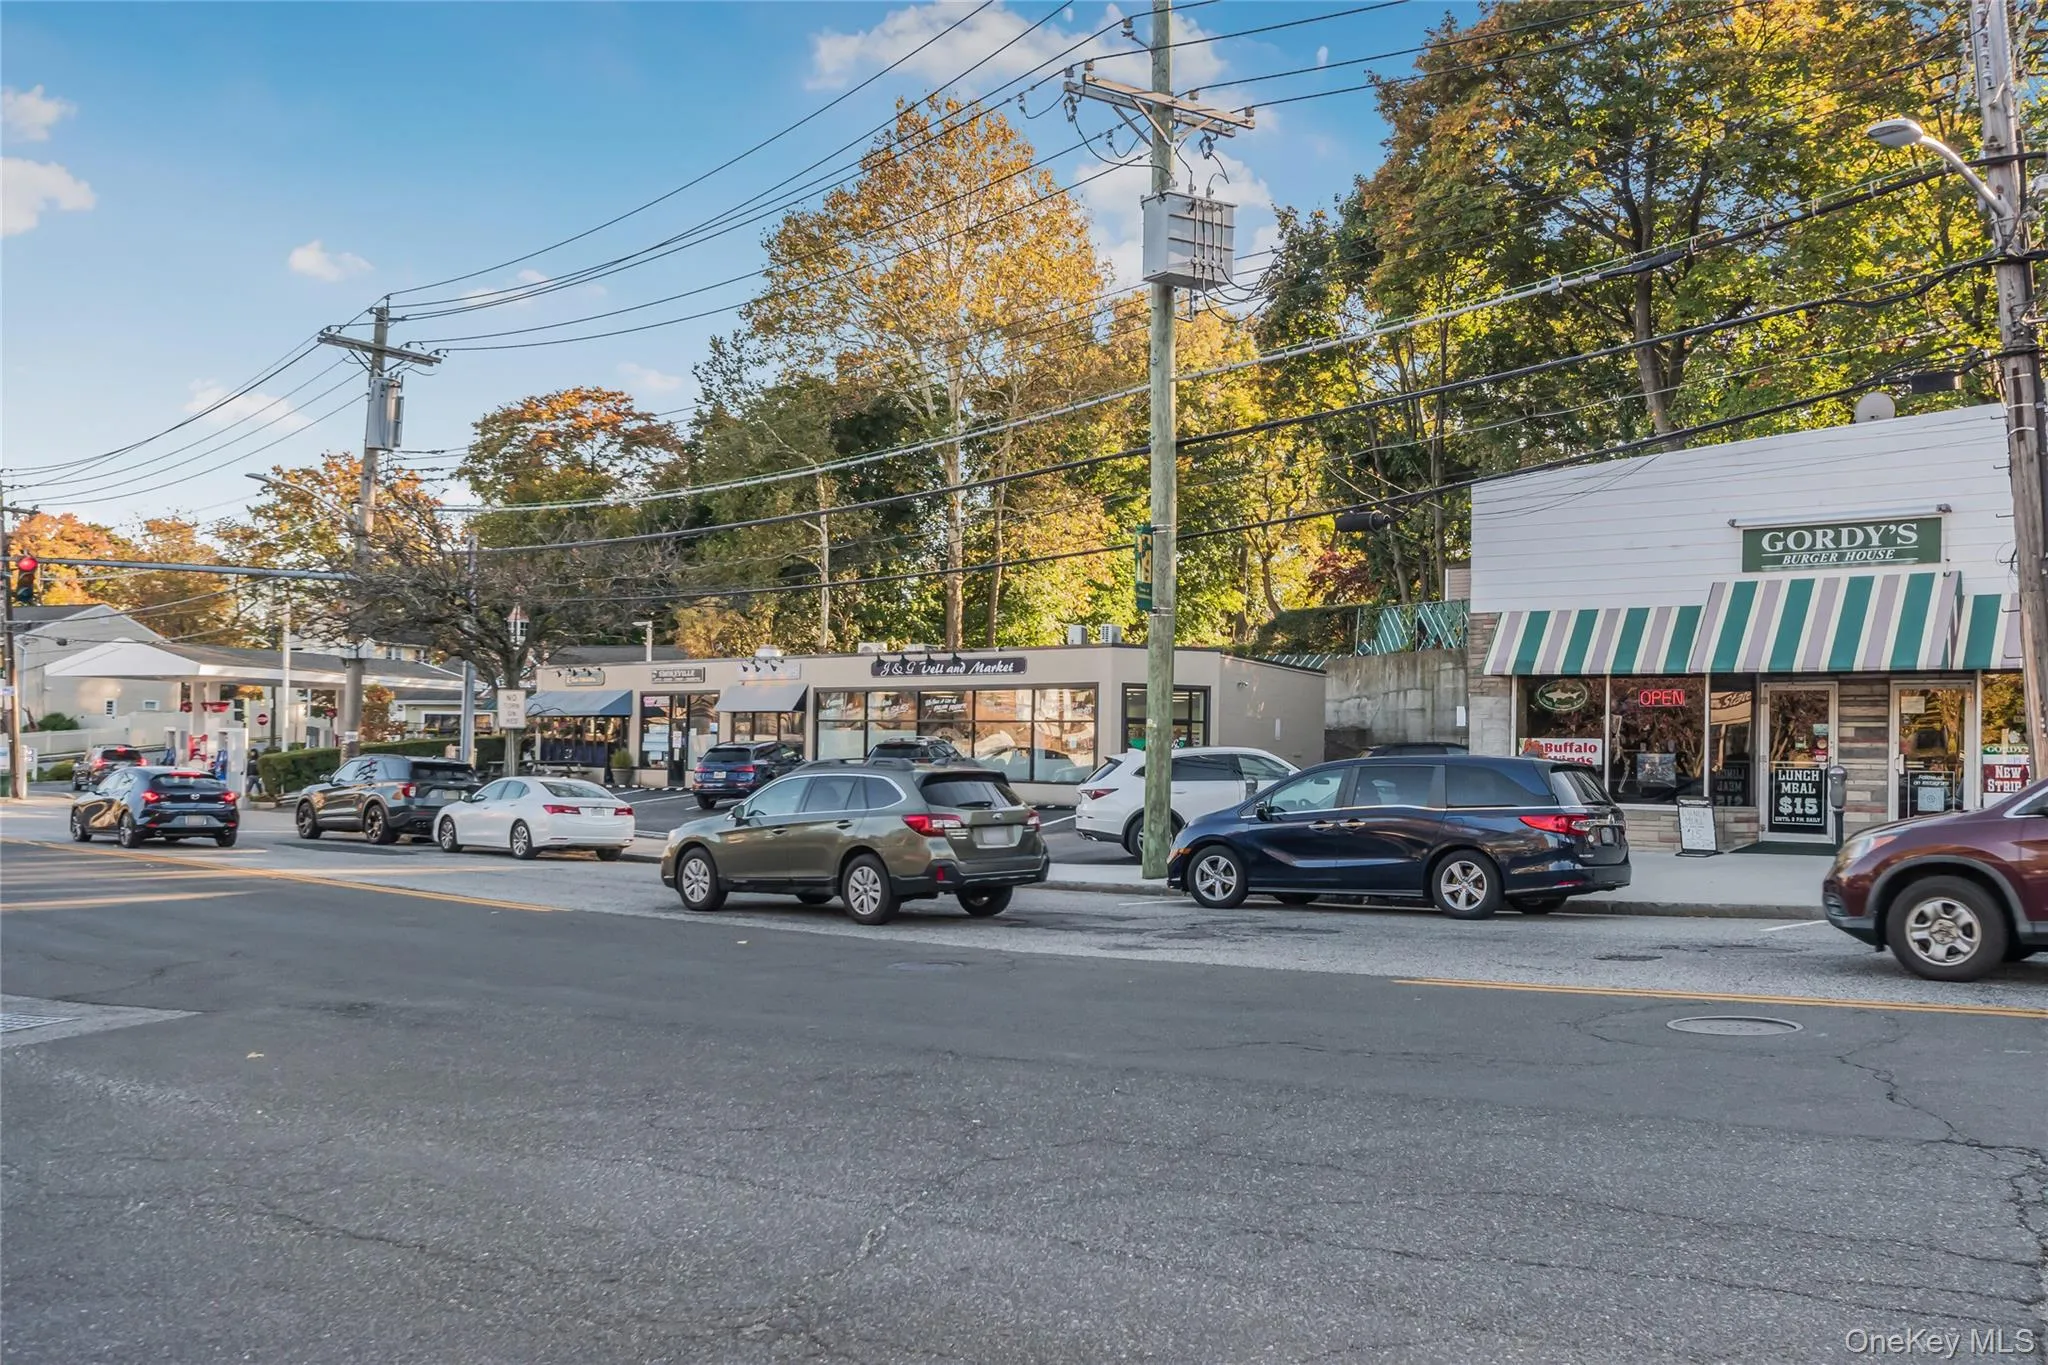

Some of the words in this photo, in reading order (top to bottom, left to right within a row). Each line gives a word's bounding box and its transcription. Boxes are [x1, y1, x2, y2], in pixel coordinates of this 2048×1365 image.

[1761, 523, 1919, 552] GORDY'S
[1782, 551, 1839, 565] BURGER
[1845, 549, 1896, 561] HOUSE
[946, 661, 965, 674] and
[968, 660, 1014, 675] Market
[1640, 690, 1685, 706] OPEN
[1544, 742, 1598, 753] Buffalo
[1778, 769, 1820, 781] LUNCH
[1995, 765, 2021, 779] NEW
[1781, 782, 1816, 794] MEAL
[1987, 779, 2022, 792] STRIP
[1779, 795, 1818, 815] $15
